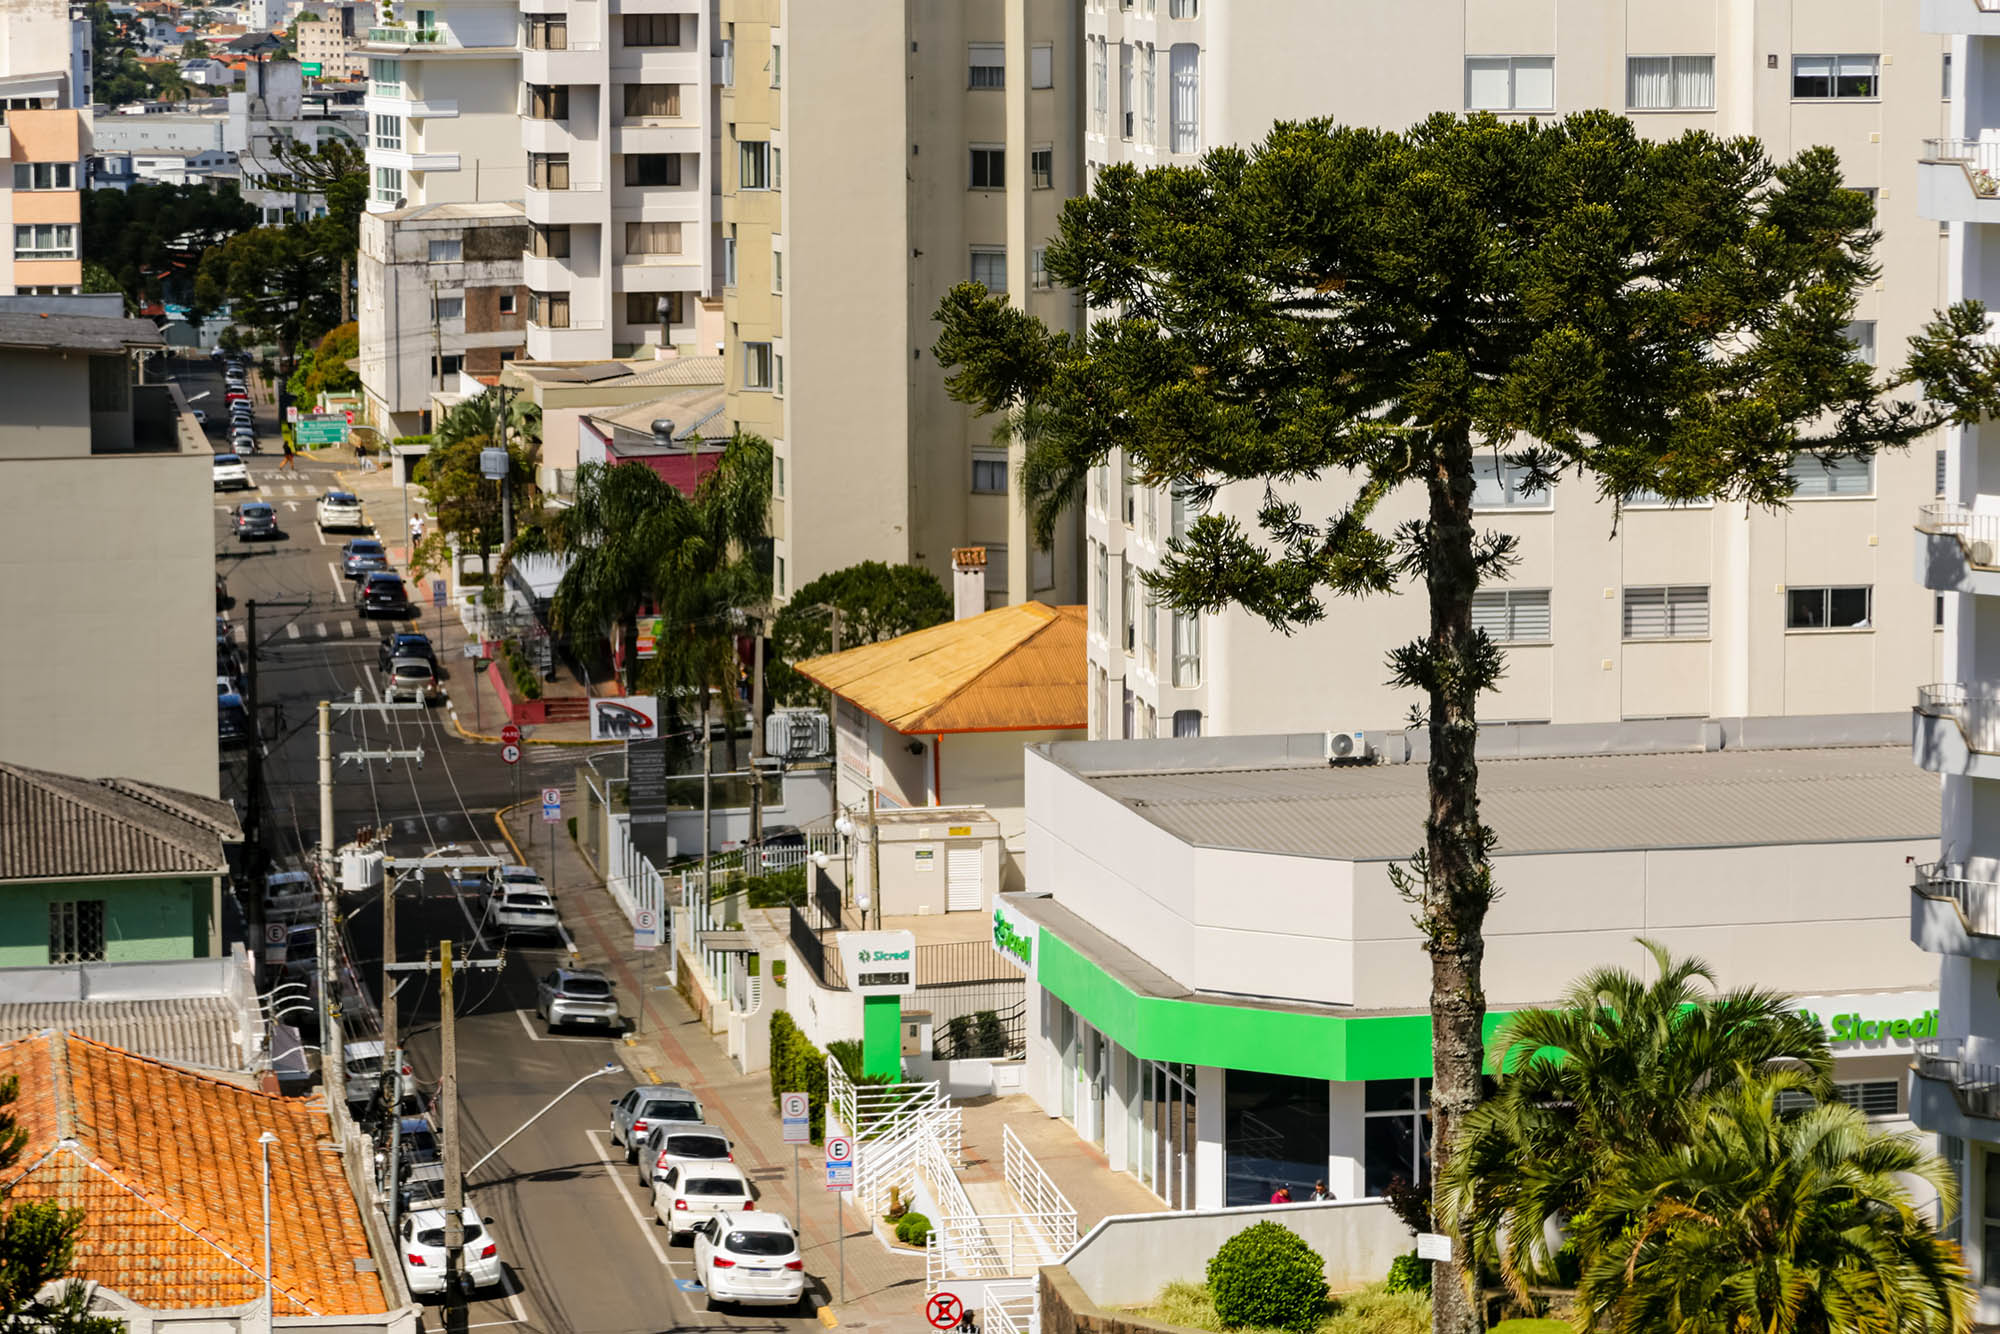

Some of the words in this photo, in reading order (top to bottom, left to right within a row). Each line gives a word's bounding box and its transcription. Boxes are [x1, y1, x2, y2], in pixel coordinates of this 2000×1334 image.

[642, 914, 649, 925] E
[272, 928, 279, 938] E
[873, 949, 910, 961] Sicredi
[1829, 1009, 1940, 1042] Sicredi
[791, 1100, 799, 1112] E
[835, 1143, 843, 1156] E
